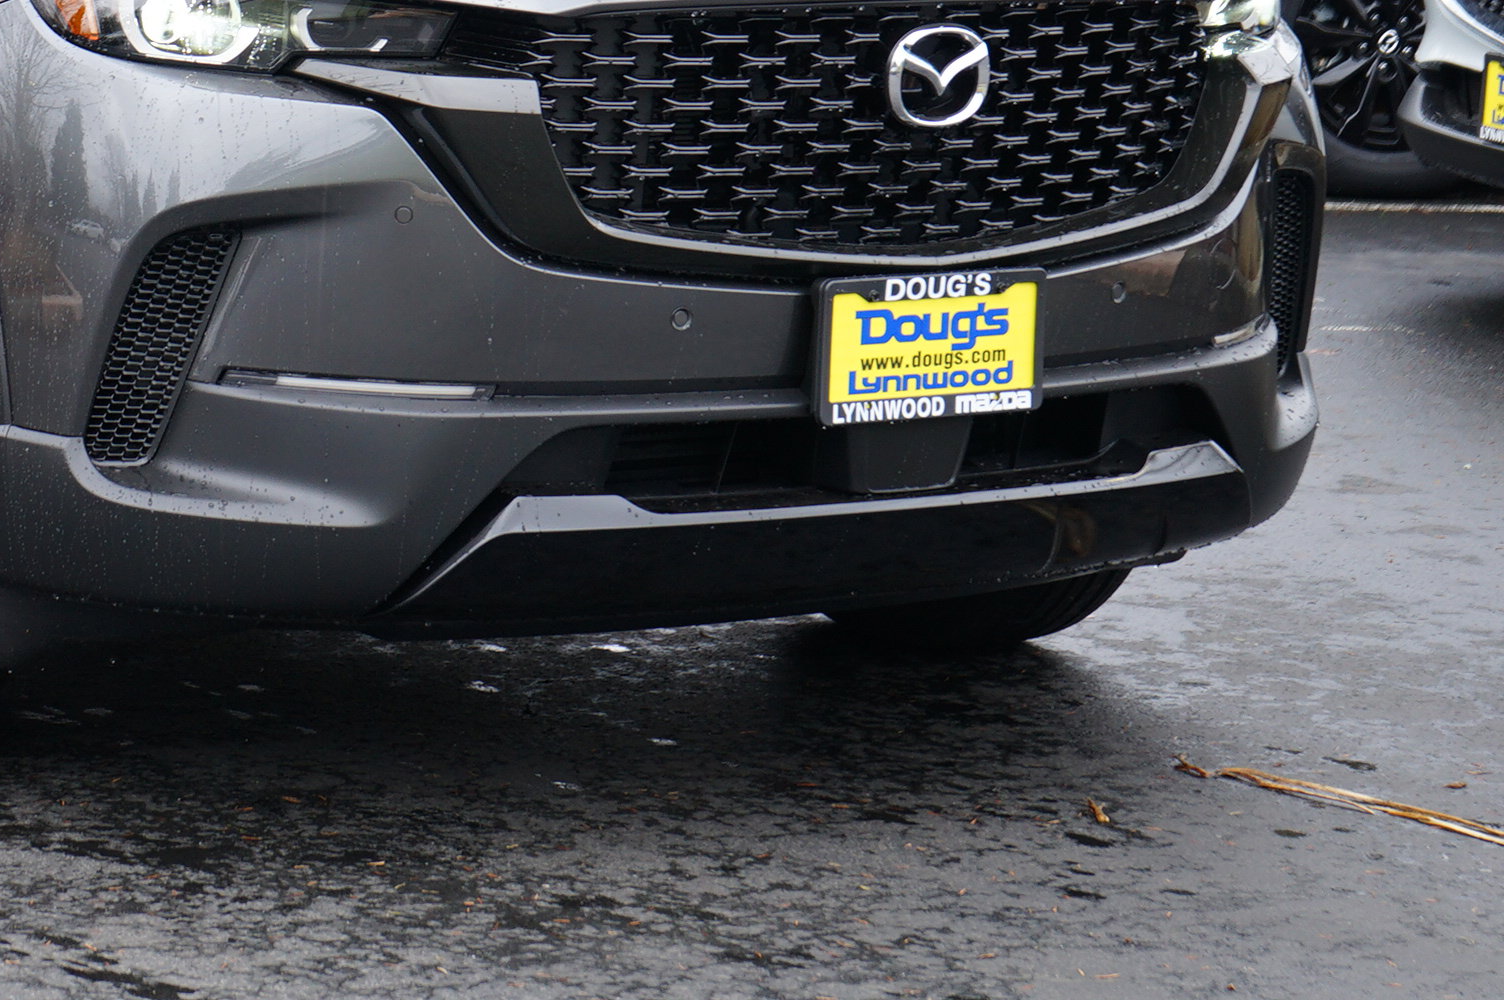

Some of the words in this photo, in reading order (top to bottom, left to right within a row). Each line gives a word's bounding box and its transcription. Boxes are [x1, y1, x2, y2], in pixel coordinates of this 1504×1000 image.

[885, 273, 992, 302] DOUG'S
[856, 303, 1010, 351] Doug's
[861, 349, 1007, 371] www.dougs.com
[848, 361, 1014, 395] Lynnwood
[832, 397, 945, 425] LYNNWOOD
